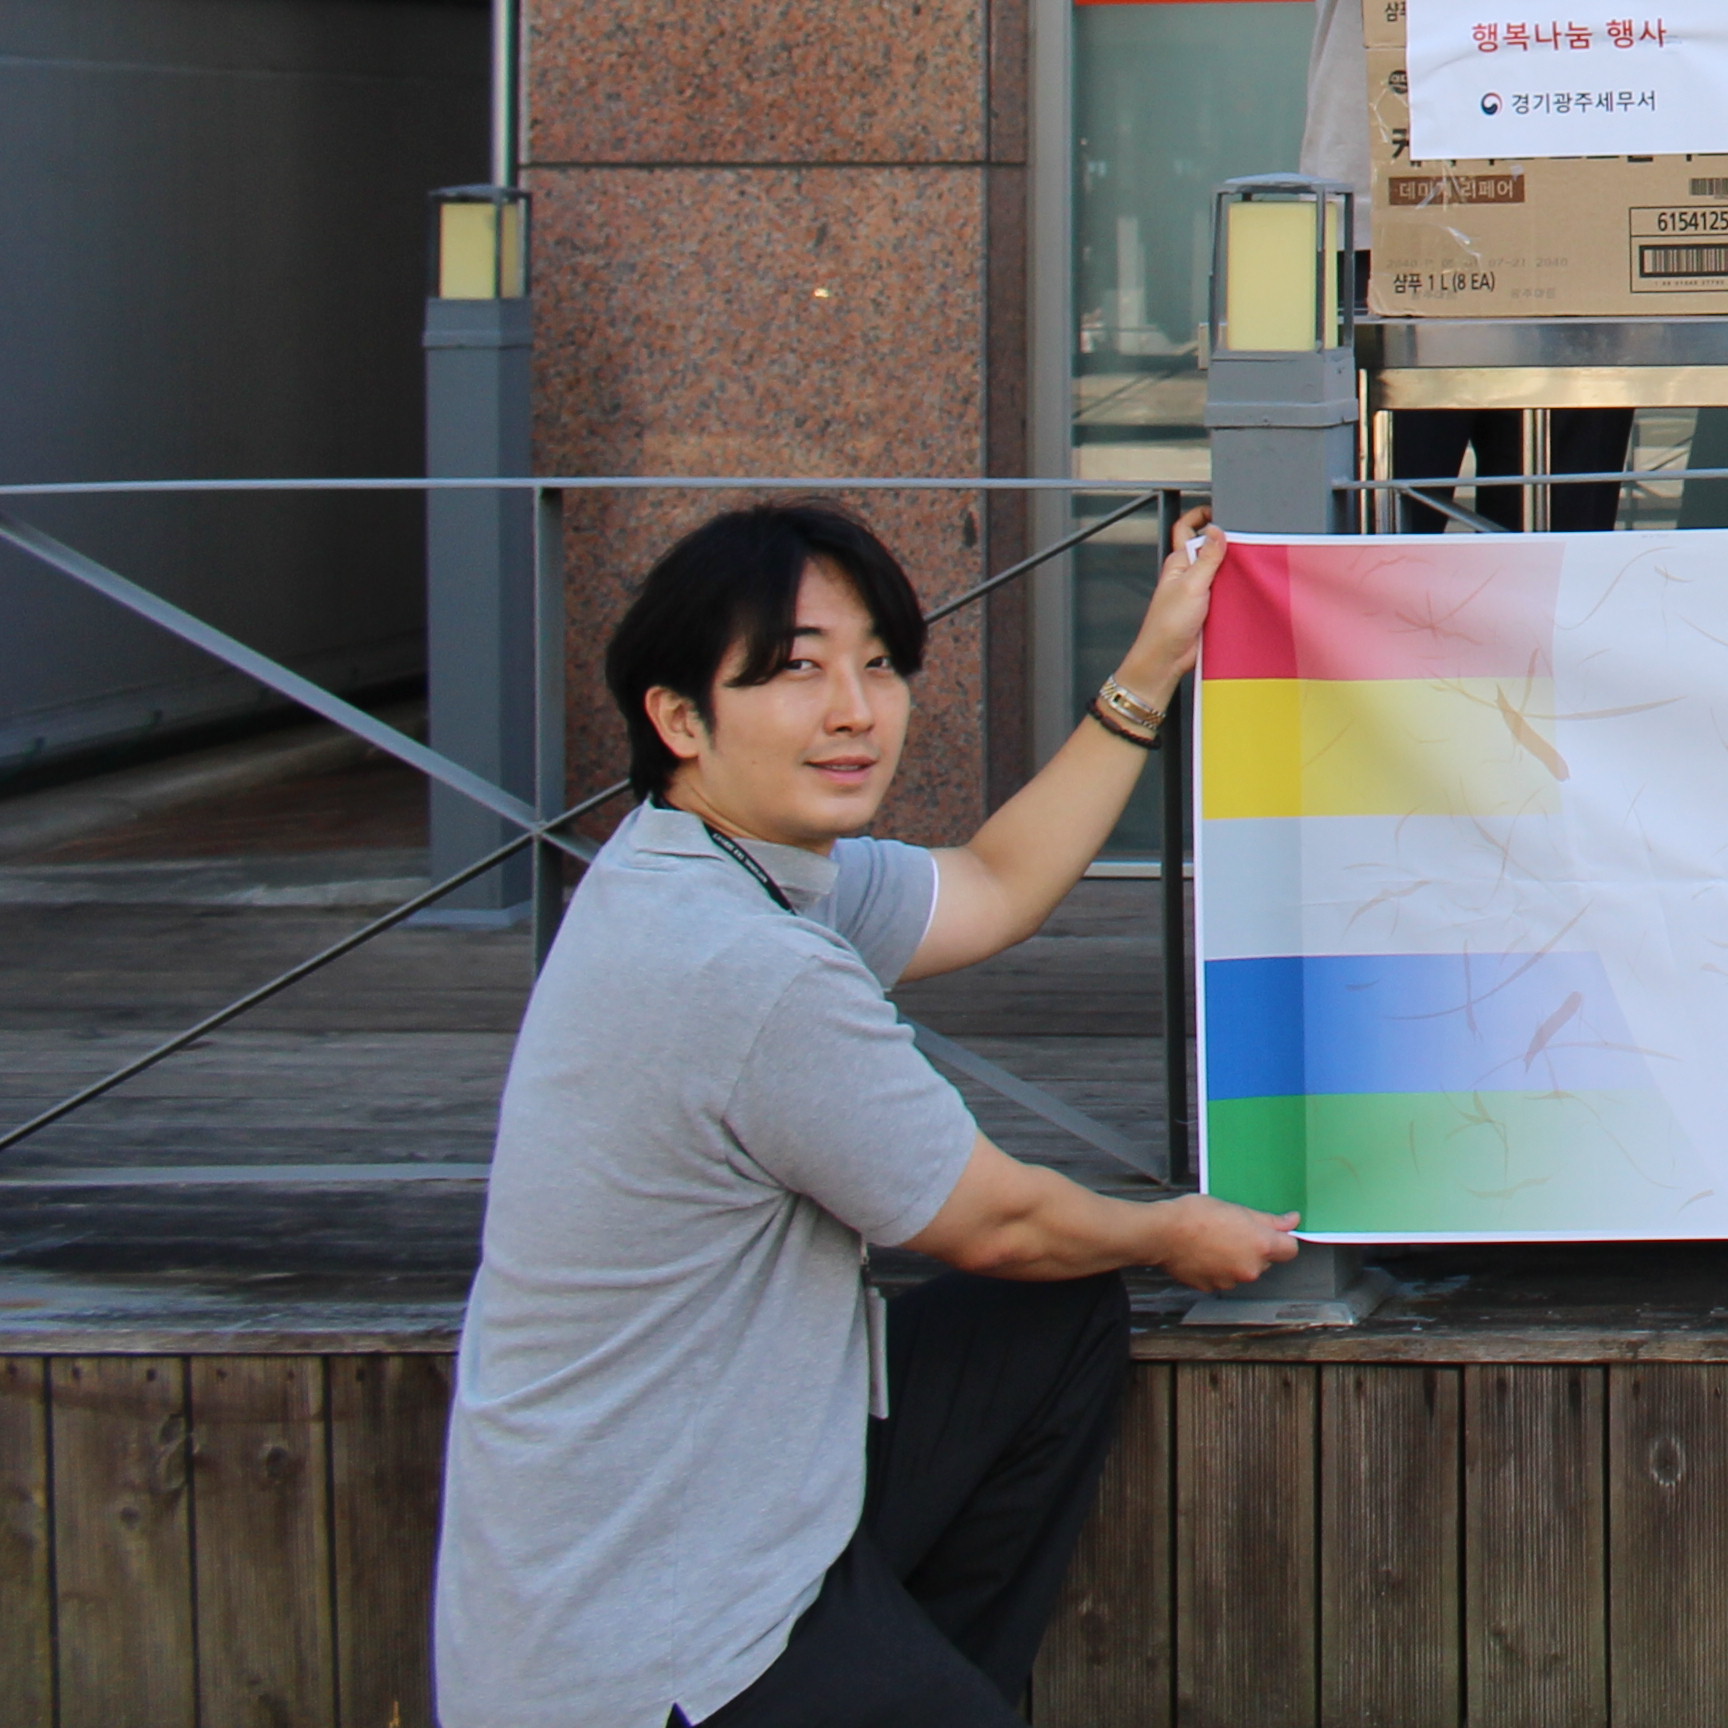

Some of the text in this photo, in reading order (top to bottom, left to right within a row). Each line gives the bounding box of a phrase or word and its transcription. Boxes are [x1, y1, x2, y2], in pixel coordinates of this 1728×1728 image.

[1471, 19, 1668, 52] 행복나눔 행사
[1511, 90, 1656, 115] 경기광주세무서
[1460, 179, 1514, 199] 리페어
[1392, 272, 1423, 294] 샴푸
[1452, 272, 1467, 293] (8
[1471, 271, 1496, 292] EA)
